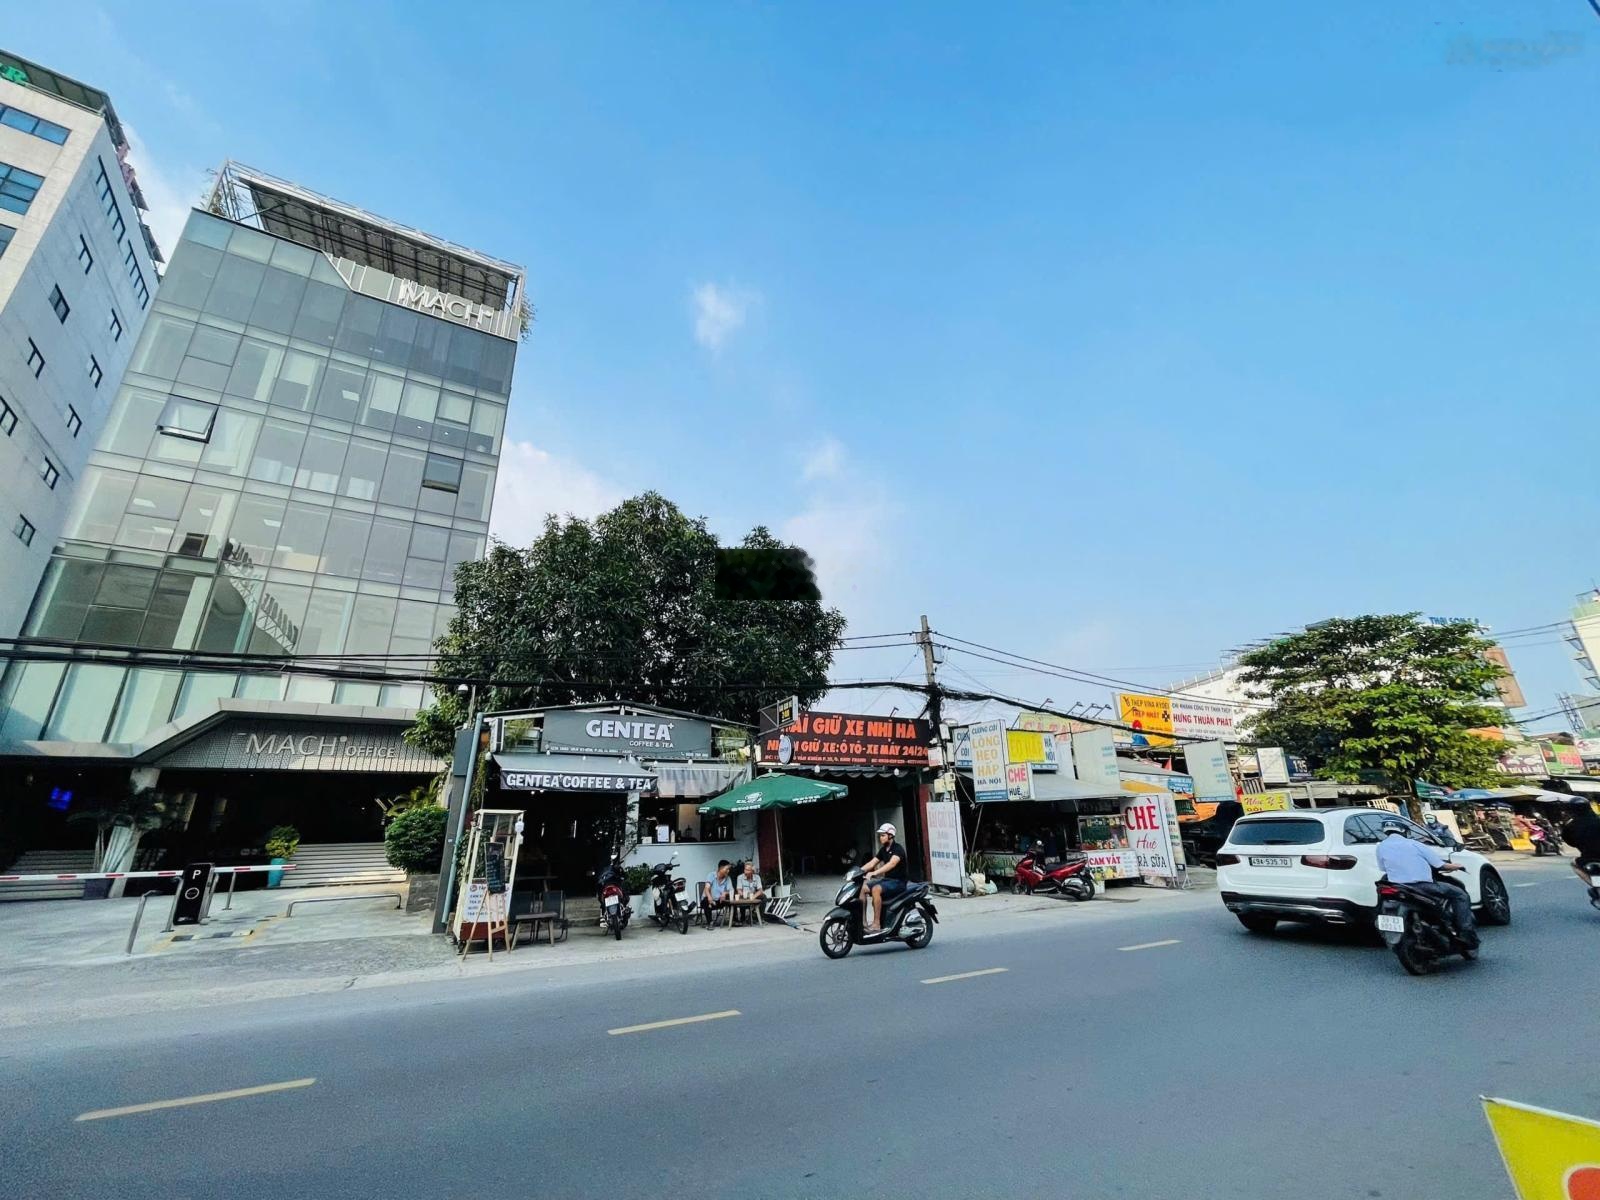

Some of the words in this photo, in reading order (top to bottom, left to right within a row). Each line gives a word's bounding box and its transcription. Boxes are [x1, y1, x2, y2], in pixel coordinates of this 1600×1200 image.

[812, 714, 842, 735] GIỮ
[844, 719, 864, 736] XE
[895, 720, 916, 739] HÀ
[246, 733, 338, 756] MACH
[345, 745, 396, 758] OFFICE
[629, 740, 655, 748] COFFEE
[801, 738, 821, 753] GIỮ
[880, 742, 901, 756] MÁY
[562, 777, 611, 789] COFFEE
[615, 778, 625, 789] &
[629, 778, 651, 790] TEA
[1125, 798, 1160, 831] CHÈ
[1089, 857, 1105, 866] CAM
[1150, 853, 1167, 868] SỮA
[192, 870, 202, 880] P
